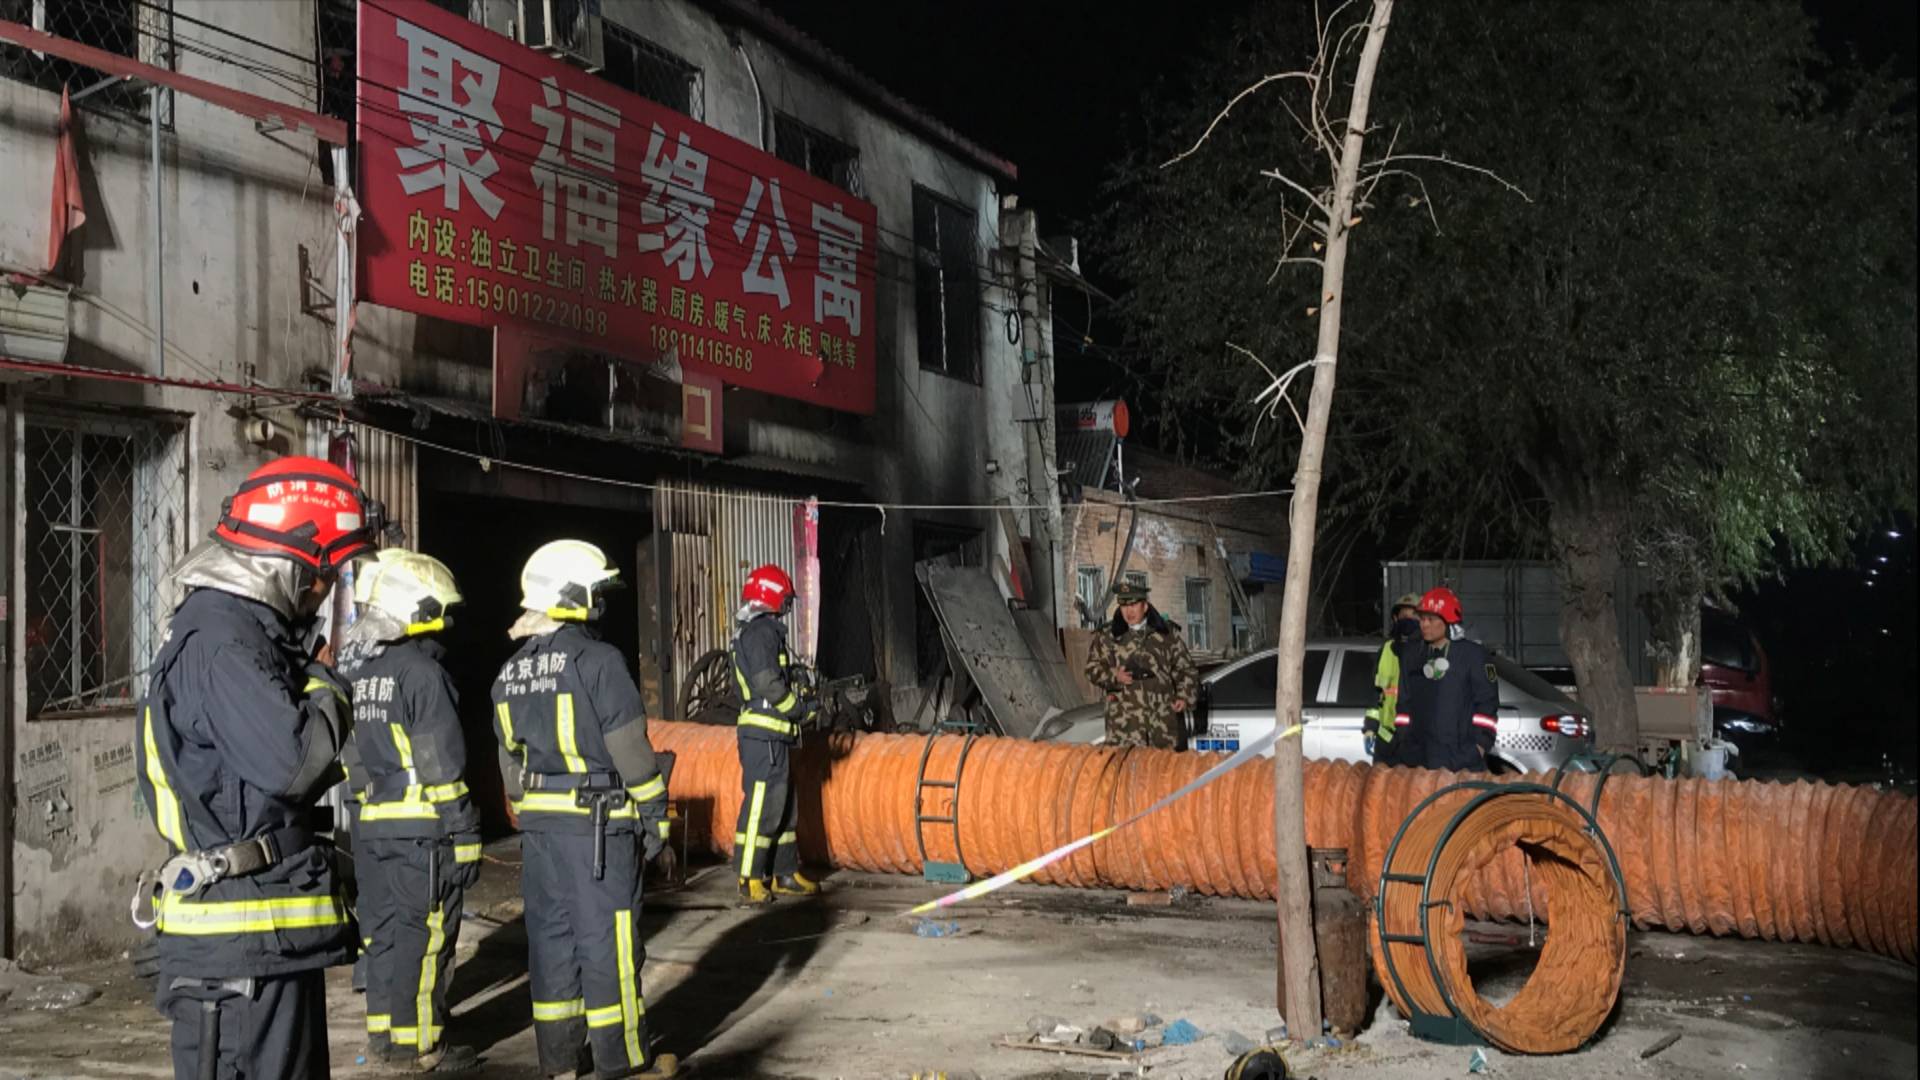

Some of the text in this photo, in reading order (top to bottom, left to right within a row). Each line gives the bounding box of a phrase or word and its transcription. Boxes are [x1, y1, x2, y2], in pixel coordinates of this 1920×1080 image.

[394, 17, 863, 337] 聚福缘公寓
[408, 209, 857, 369] 内设:独立卫生间、热水器、厨房、暖气、床、衣柜网线等
[498, 651, 567, 682] 北京消防
[352, 676, 395, 704] 京消防
[506, 682, 526, 696] Fire
